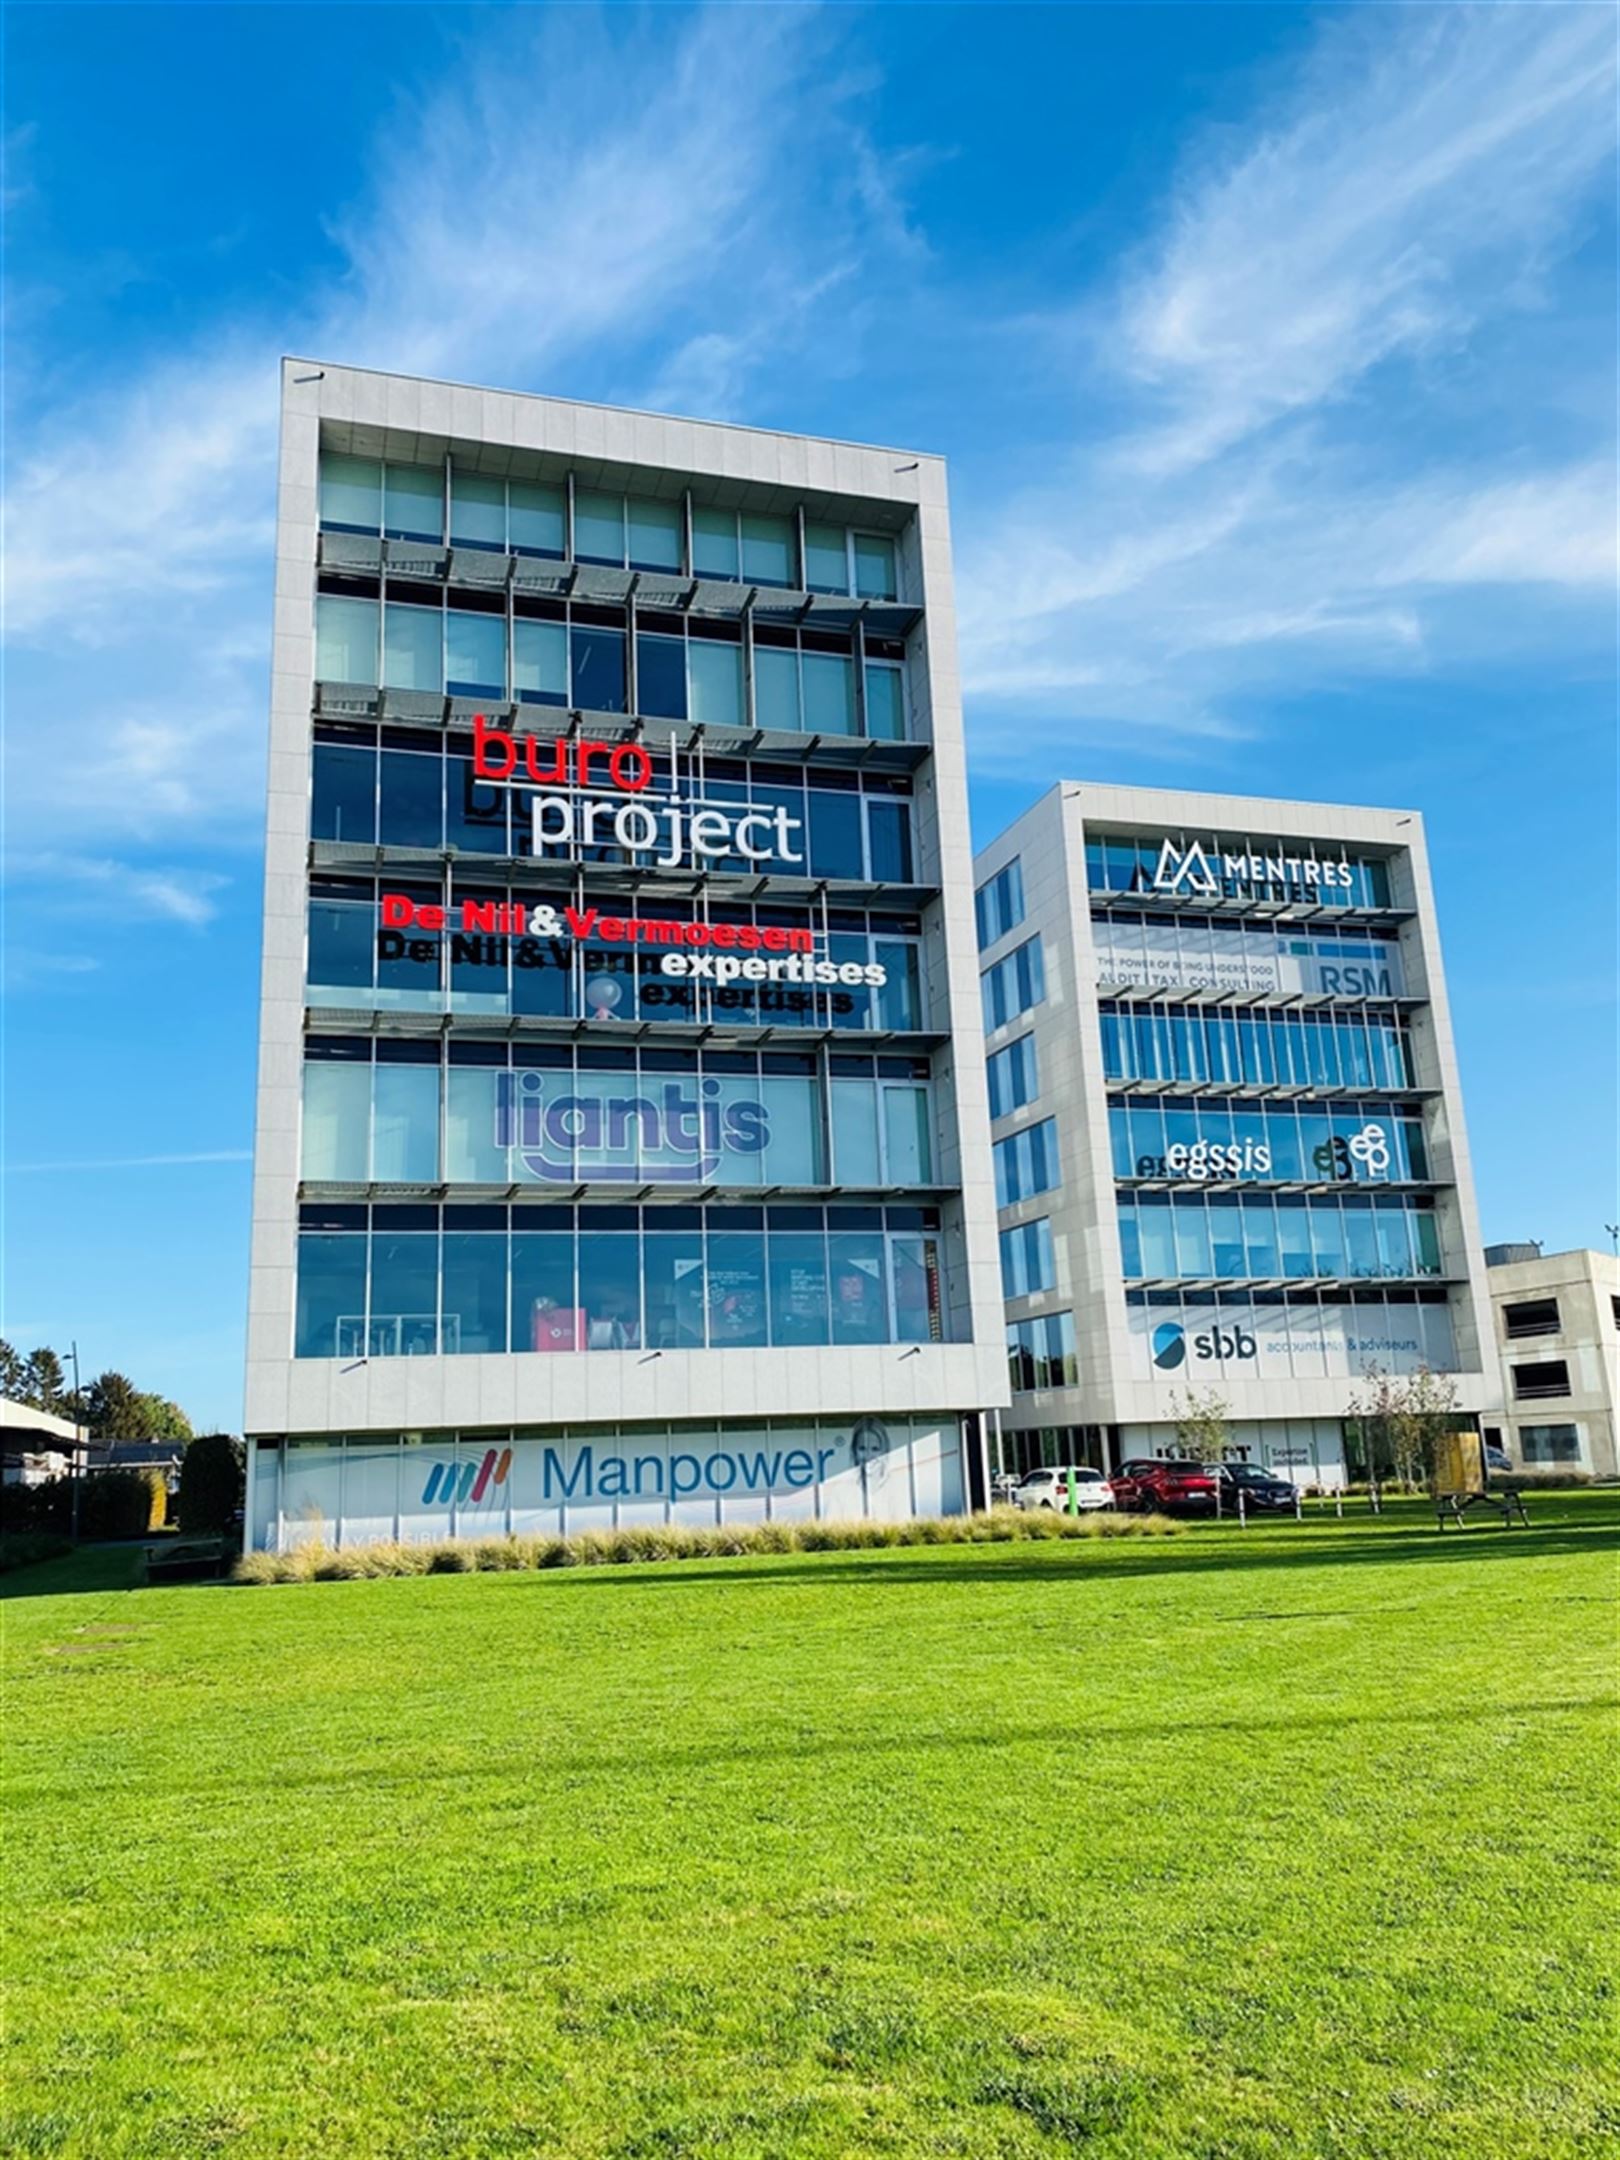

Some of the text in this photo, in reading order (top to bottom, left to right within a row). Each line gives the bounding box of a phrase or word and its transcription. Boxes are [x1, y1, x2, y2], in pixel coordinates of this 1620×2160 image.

[473, 714, 652, 791] buro
[532, 794, 802, 866] project
[1224, 853, 1353, 887] MENTRES
[381, 894, 444, 929] De
[660, 952, 887, 987] expertises
[1152, 974, 1178, 986] TAX
[1157, 960, 1170, 969] OF
[1172, 961, 1203, 972] BING
[1205, 963, 1273, 976] UDERSOOD
[1320, 966, 1391, 996] RSM
[495, 1072, 771, 1152] liantis
[1169, 1137, 1272, 1179] egssis
[1195, 1325, 1257, 1359] sbb
[1346, 1336, 1357, 1351] &
[1359, 1336, 1418, 1351] adviseurs
